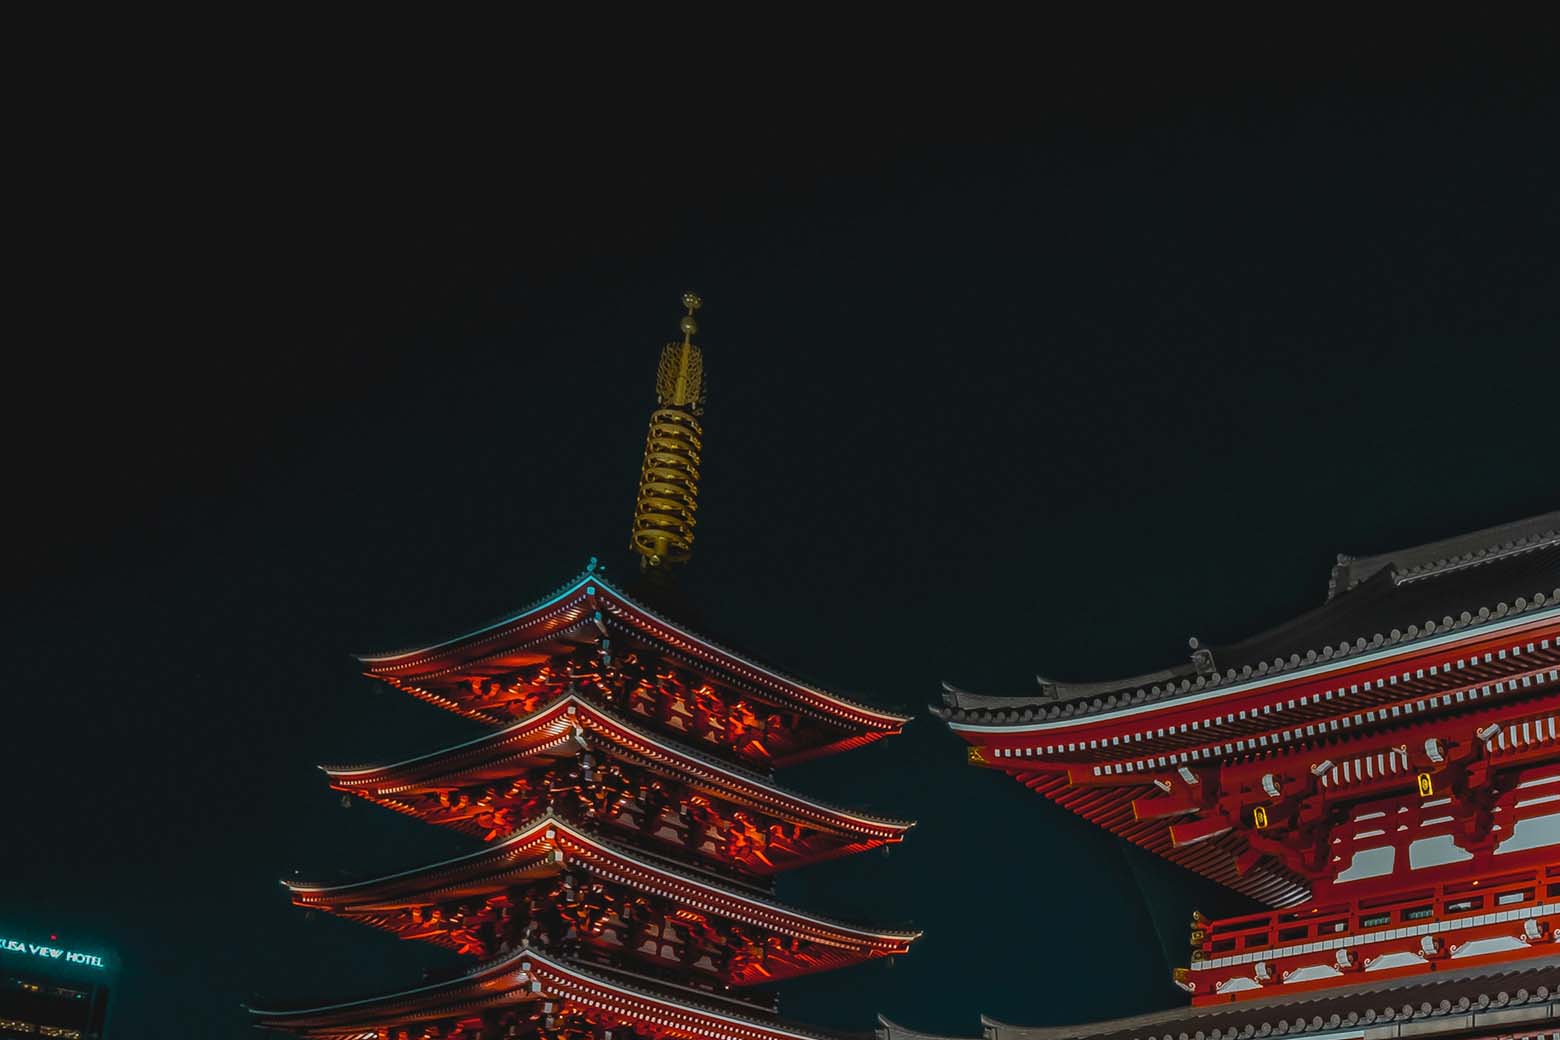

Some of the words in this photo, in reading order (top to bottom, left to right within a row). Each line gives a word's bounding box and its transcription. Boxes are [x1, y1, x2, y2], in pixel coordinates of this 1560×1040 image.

[0, 938, 27, 953] USA
[28, 943, 64, 960] VIEW
[66, 951, 104, 967] HOTEL
